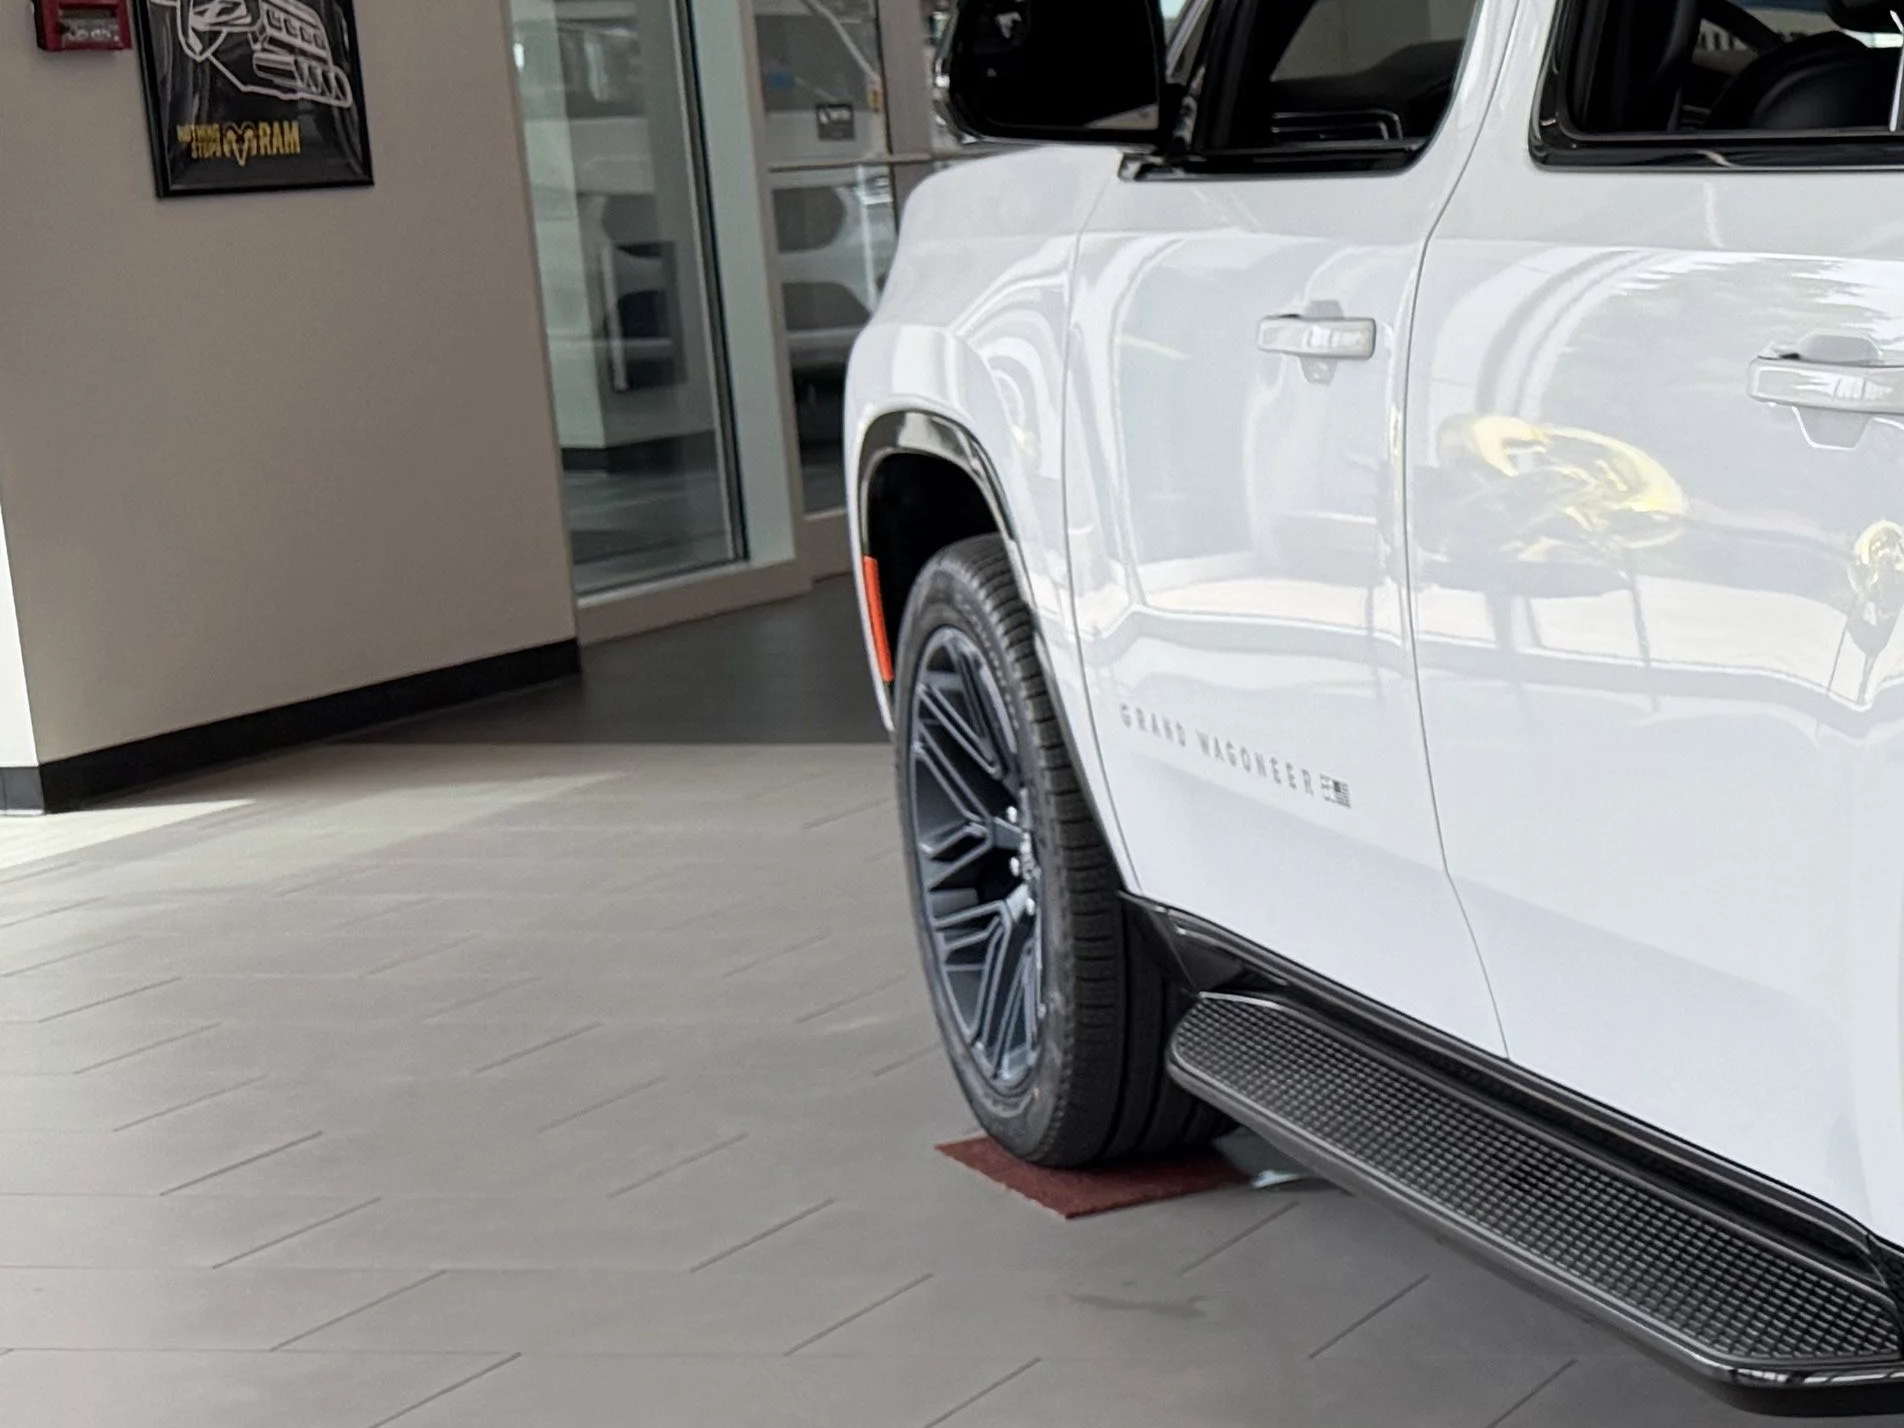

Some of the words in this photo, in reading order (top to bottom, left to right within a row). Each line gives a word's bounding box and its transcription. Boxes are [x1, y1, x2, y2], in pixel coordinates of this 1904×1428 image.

[258, 120, 301, 156] RAM
[1119, 702, 1187, 748] GRAND
[1196, 729, 1315, 796] WAGONEER
